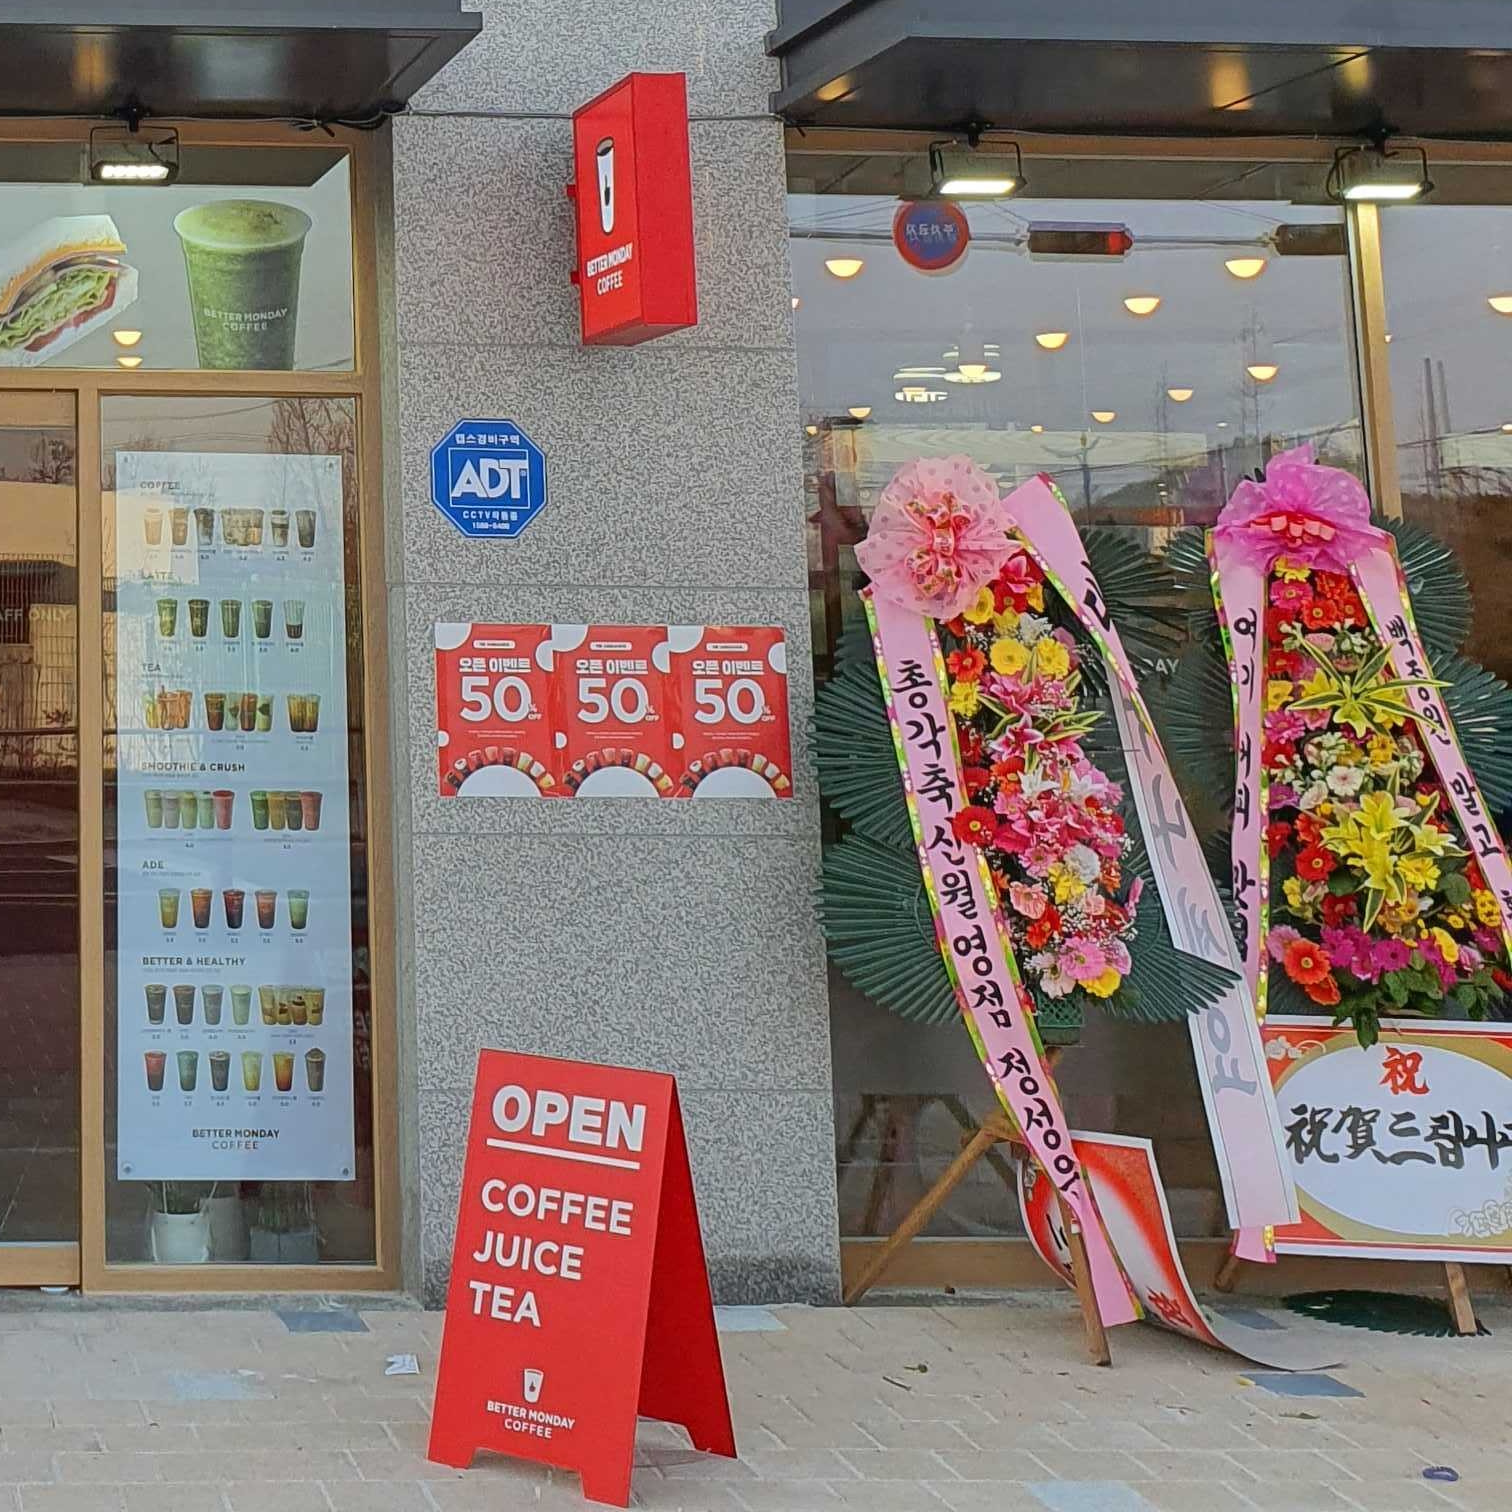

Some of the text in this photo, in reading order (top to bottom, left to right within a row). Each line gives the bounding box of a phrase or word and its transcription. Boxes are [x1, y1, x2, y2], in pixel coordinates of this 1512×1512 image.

[597, 269, 624, 296] COFFEE
[451, 457, 529, 499] ADT
[28, 607, 72, 623] ONLY
[141, 663, 162, 674] TEA
[209, 762, 246, 774] CRUSH
[142, 860, 165, 870] ADE
[142, 956, 183, 967] BETTER
[196, 956, 246, 967] HEALTHY
[1380, 1045, 1431, 1096] 祝
[490, 1083, 648, 1153] OPEN
[192, 1128, 280, 1139] BETTER MONDAY
[211, 1140, 259, 1151] COFFEE
[480, 1178, 635, 1236] COFFEE
[472, 1229, 585, 1281] JUICE
[468, 1280, 542, 1328] TEA
[486, 1399, 576, 1431] BETTER MONDAY
[503, 1417, 553, 1440] COFFEE
